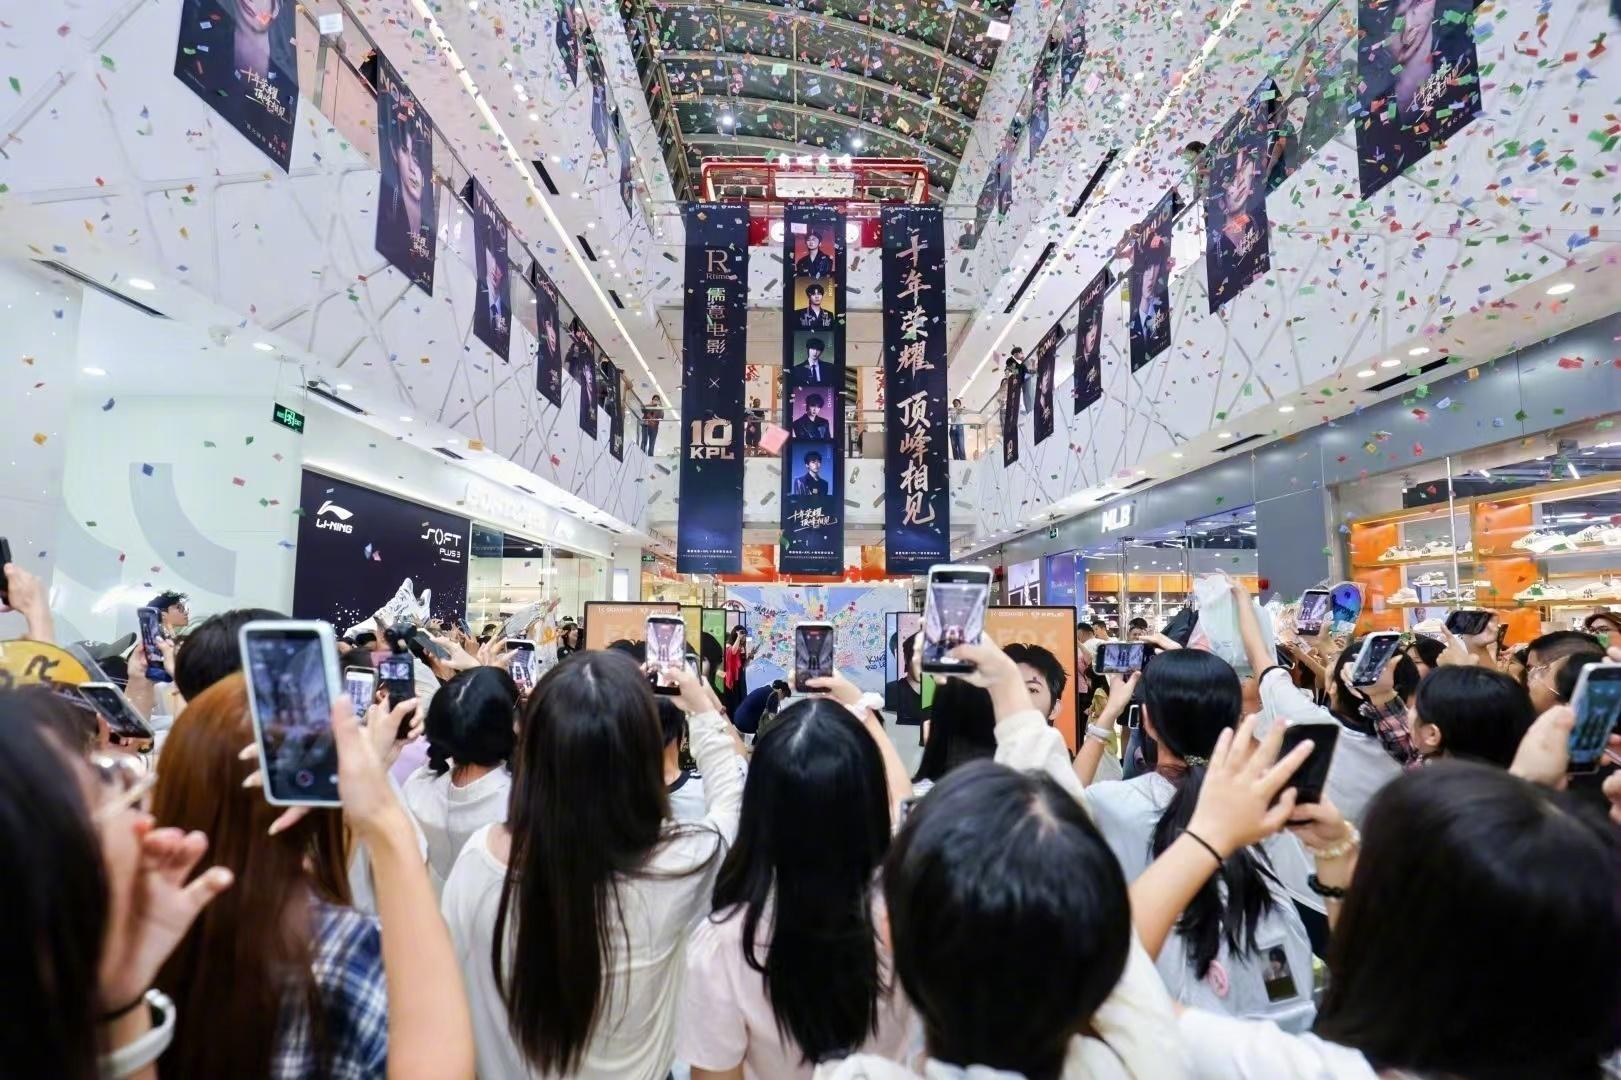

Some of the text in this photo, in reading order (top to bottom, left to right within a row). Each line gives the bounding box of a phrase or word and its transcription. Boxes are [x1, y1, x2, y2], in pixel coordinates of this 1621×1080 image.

[896, 234, 935, 380] 十年荣耀
[706, 287, 726, 354] 儒意电影
[690, 414, 733, 446] 10
[690, 447, 735, 460] KPL
[896, 390, 936, 527] 顶峰相见
[787, 507, 824, 521] 十年荣耀
[316, 519, 353, 534] LI-NING
[421, 528, 461, 546] SOFT
[439, 548, 456, 557] PLUS
